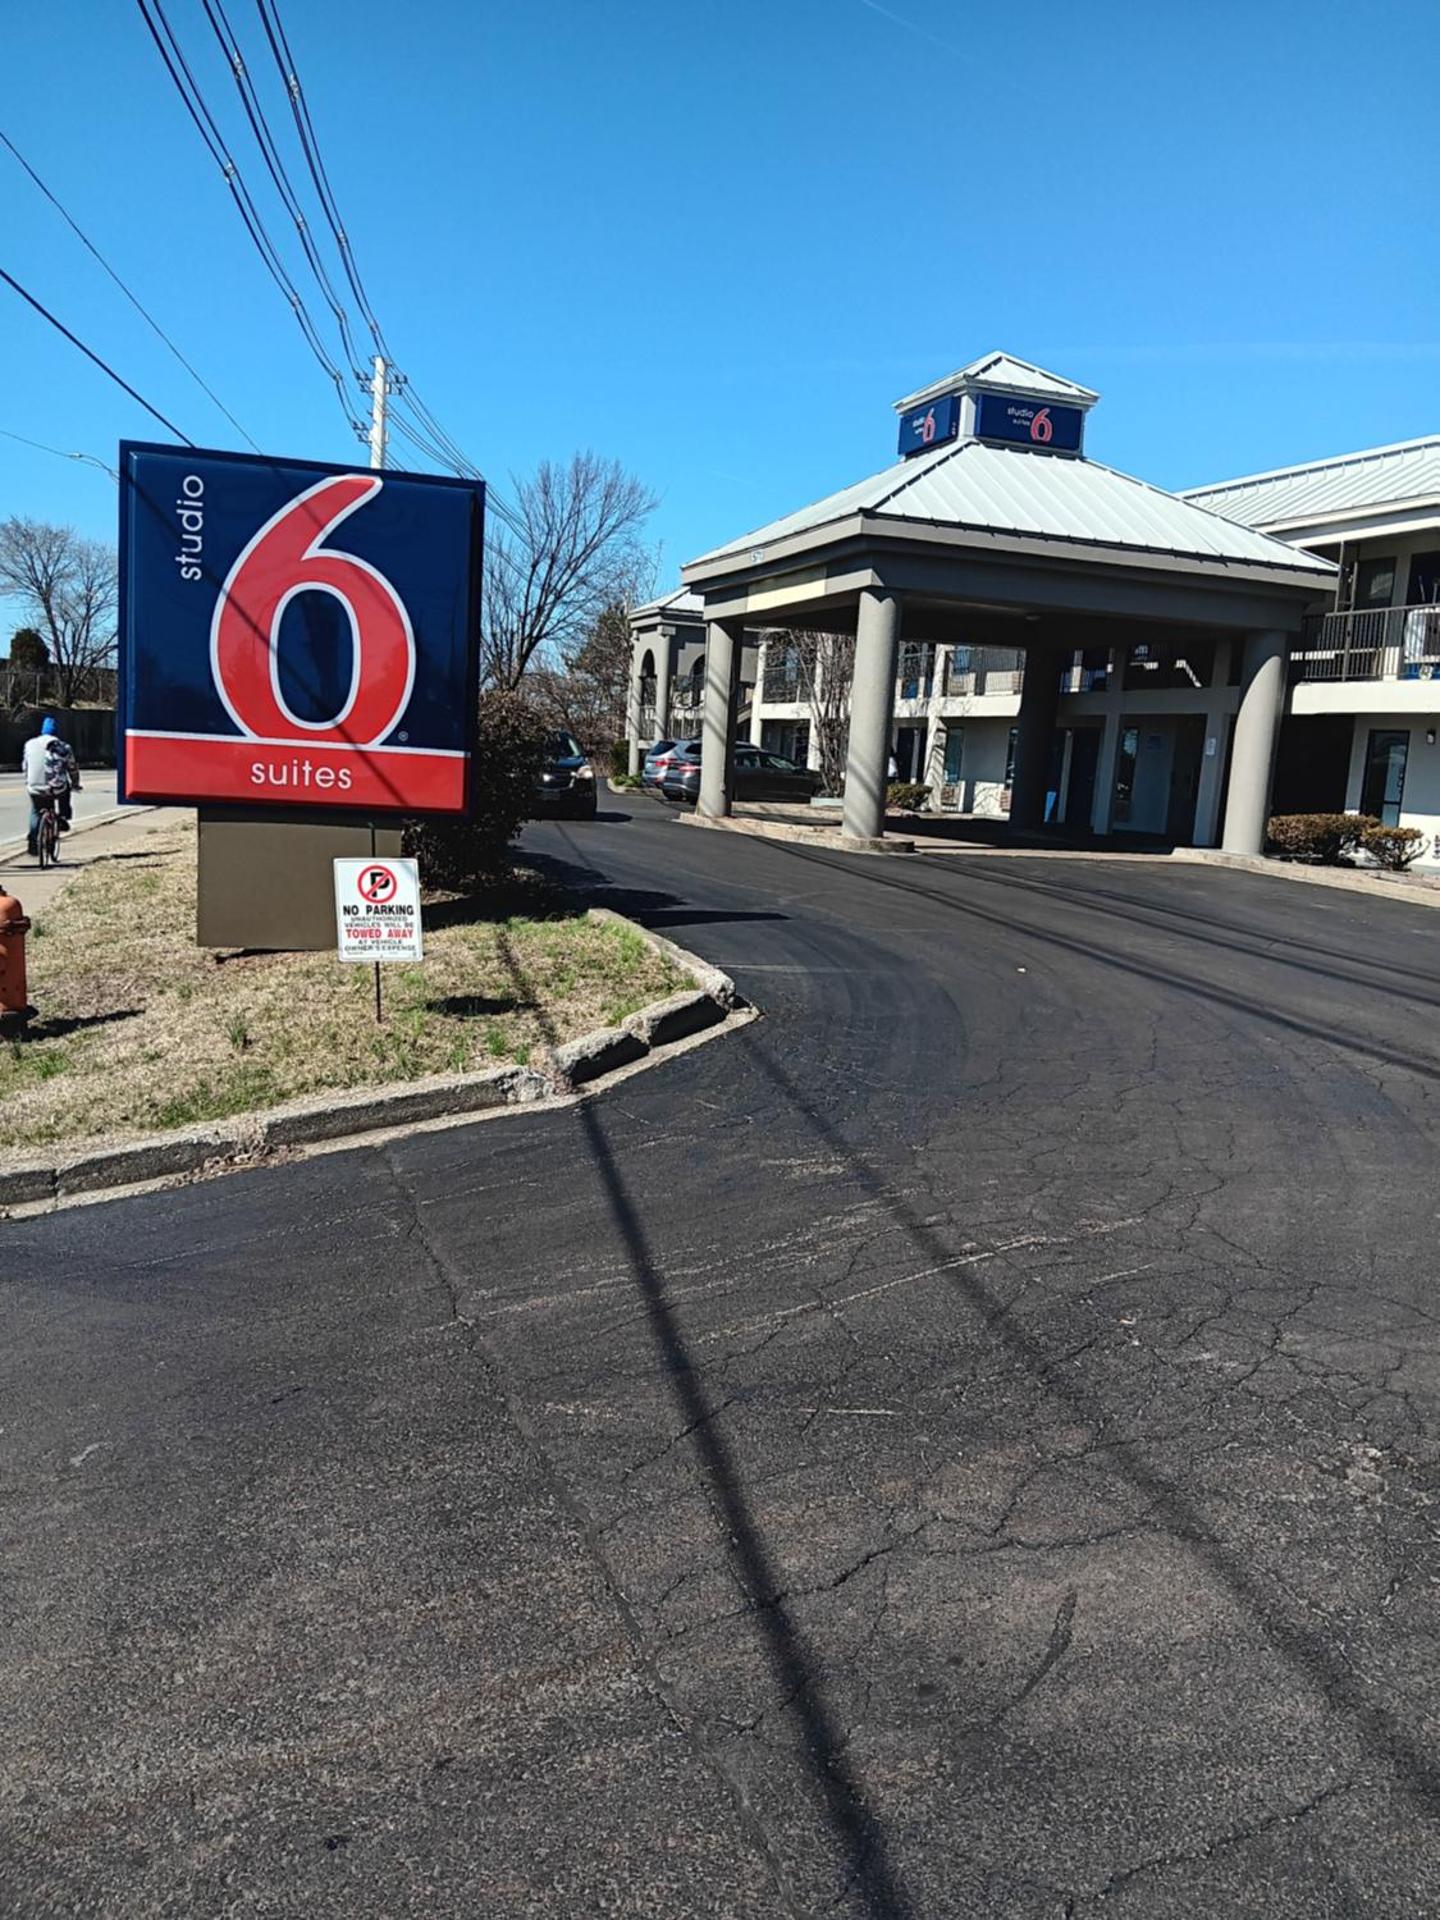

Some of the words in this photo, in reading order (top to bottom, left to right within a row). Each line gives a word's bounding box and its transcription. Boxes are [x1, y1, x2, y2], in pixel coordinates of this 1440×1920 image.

[922, 407, 936, 443] 6
[1007, 406, 1034, 418] studio
[1030, 407, 1053, 442] 6
[176, 475, 205, 581] studio
[209, 472, 416, 748] 6
[250, 759, 353, 790] suites
[342, 904, 360, 916] NO
[365, 904, 415, 916] PARKING
[345, 928, 382, 939] TOWED
[387, 928, 414, 939] AWAY
